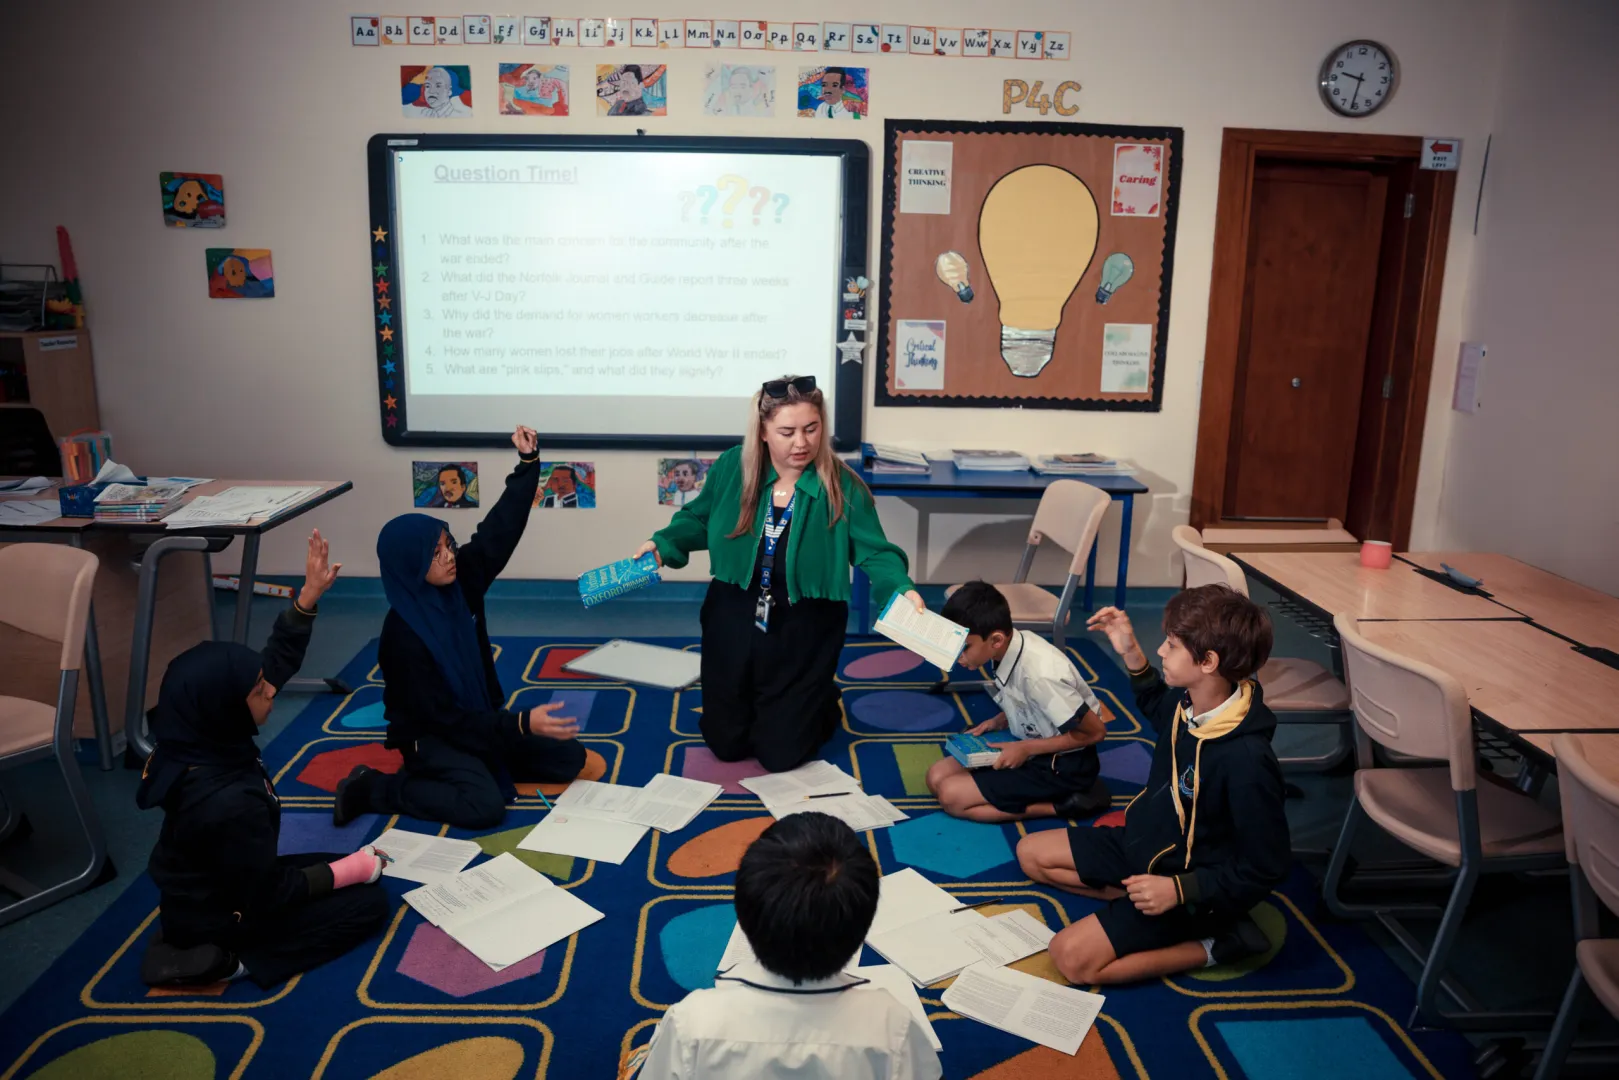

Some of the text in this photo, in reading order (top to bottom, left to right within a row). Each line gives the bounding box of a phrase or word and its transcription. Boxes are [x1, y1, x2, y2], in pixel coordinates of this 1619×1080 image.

[1358, 47, 1368, 56] 12
[1378, 62, 1386, 70] 2
[1330, 74, 1338, 82] 9
[1380, 76, 1388, 84] 3
[1002, 79, 1082, 116] P4C
[1332, 88, 1340, 96] 8
[1341, 98, 1347, 106] 7
[1364, 99, 1372, 107] 5
[433, 164, 579, 184] Question Time!
[908, 168, 946, 176] CREATIVE
[1119, 174, 1158, 187] Caring
[439, 232, 472, 246] What
[474, 235, 499, 246] was
[502, 233, 522, 246] the
[629, 236, 649, 247] the
[650, 237, 716, 250] community
[720, 236, 747, 249] after
[751, 237, 769, 249] the
[440, 252, 511, 265] war ended?
[440, 270, 473, 283] What
[476, 270, 494, 283] did
[497, 270, 516, 283] the
[613, 273, 636, 286] and
[679, 275, 714, 288] report
[441, 289, 468, 302] after
[494, 290, 527, 305] Day?
[441, 308, 470, 322] Why
[472, 308, 491, 321] did
[494, 308, 514, 321] the
[742, 312, 769, 324] after
[442, 327, 495, 340] the war?
[906, 337, 936, 352] Critical
[443, 345, 470, 358] How
[473, 347, 507, 360] many
[509, 347, 553, 358] women
[555, 345, 577, 358] lost
[579, 345, 608, 358] their
[637, 346, 664, 359] after
[666, 347, 702, 359] World
[705, 347, 729, 359] War
[743, 348, 789, 361] ended?
[444, 362, 476, 375] What
[478, 365, 498, 375] are
[571, 364, 595, 376] and
[597, 364, 626, 377] what
[628, 365, 647, 377] did
[649, 365, 676, 380] they
[585, 586, 624, 606] OXFORD
[622, 575, 650, 588] PRIMARY
